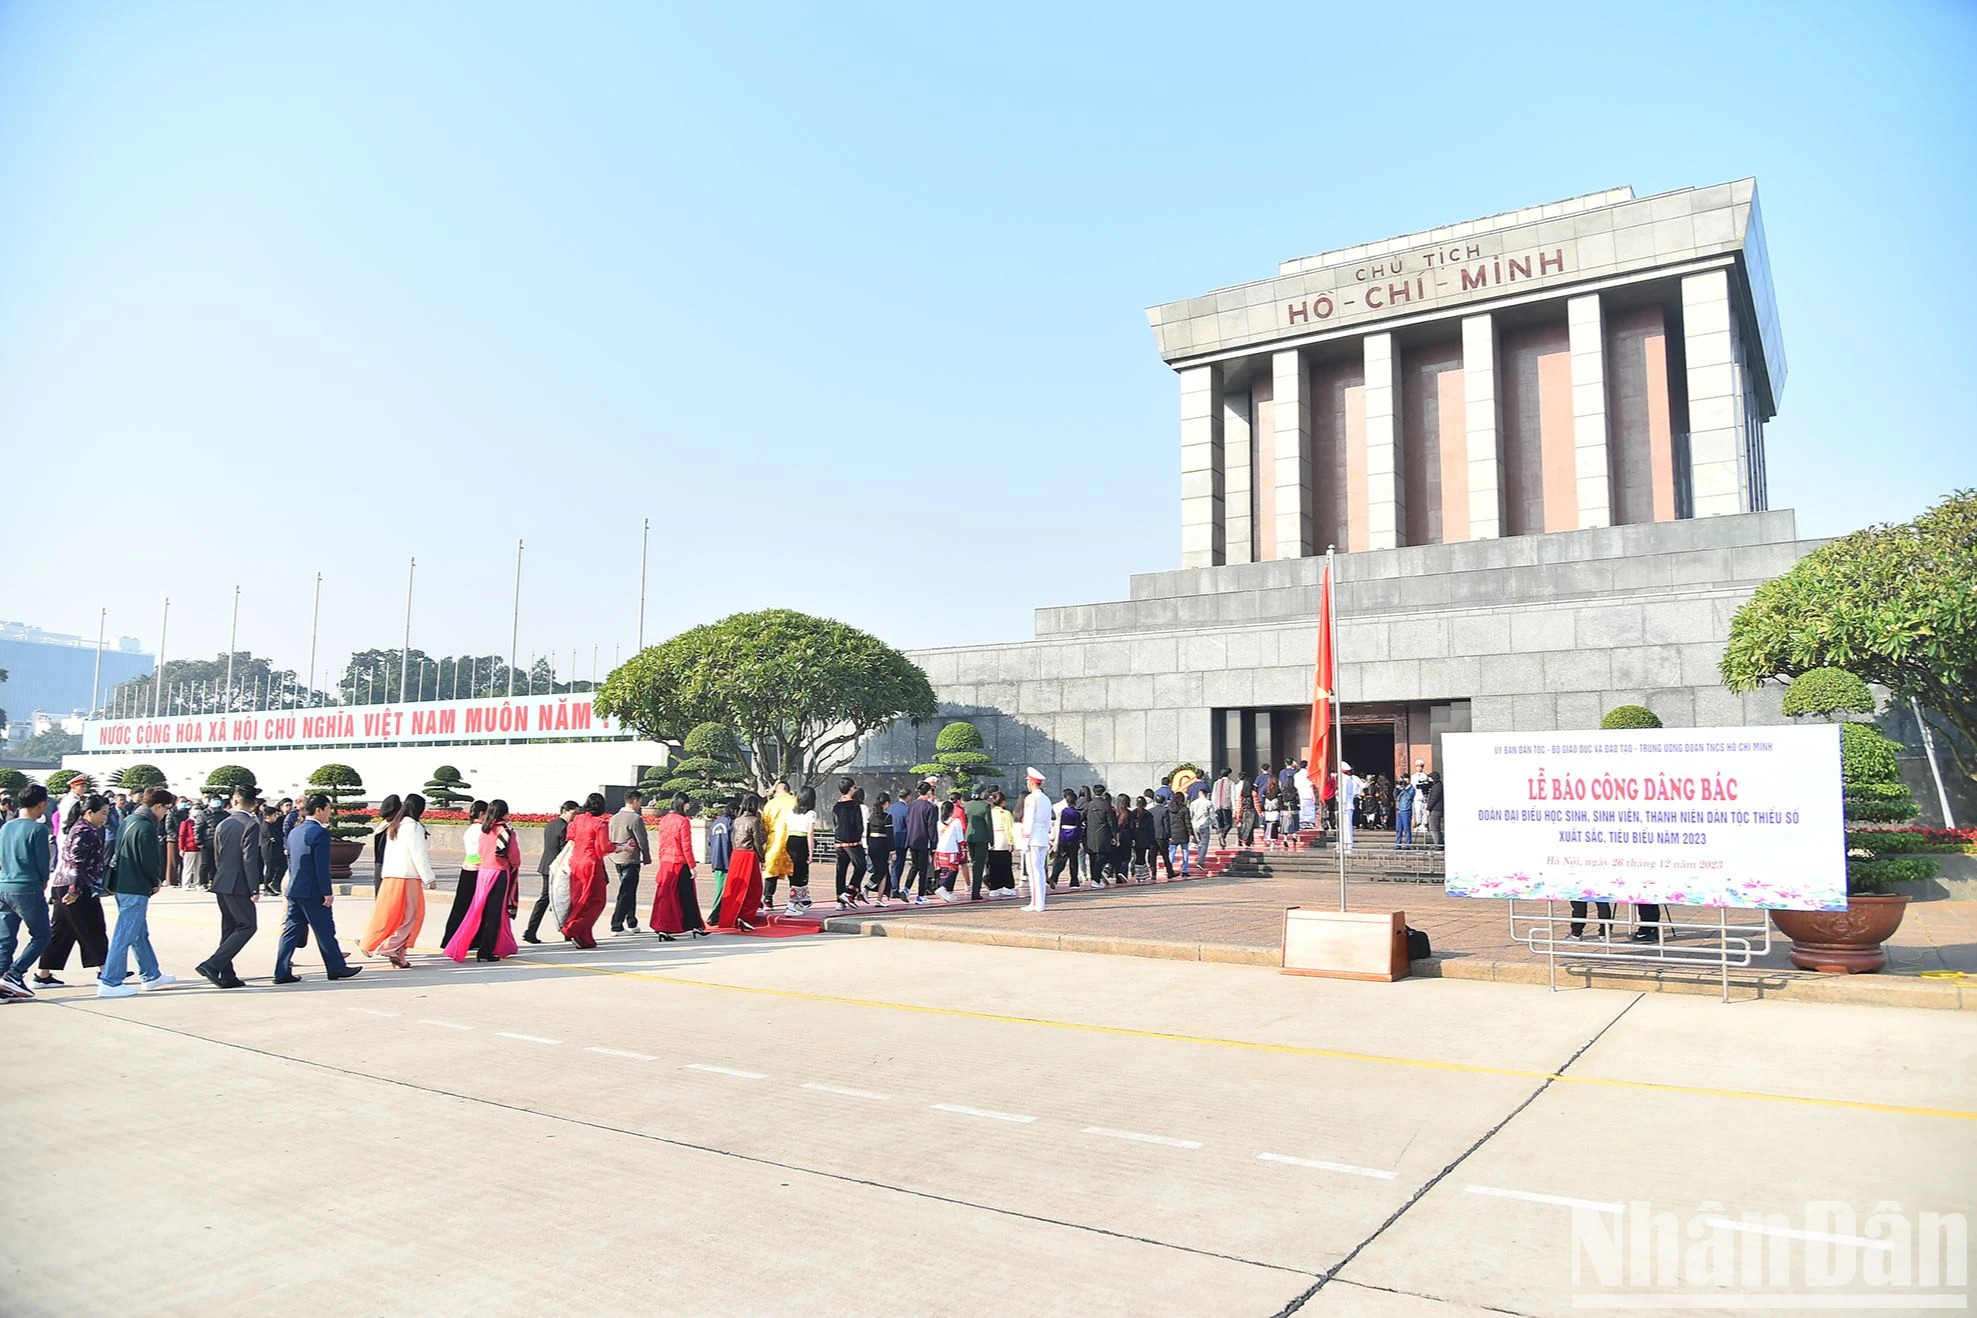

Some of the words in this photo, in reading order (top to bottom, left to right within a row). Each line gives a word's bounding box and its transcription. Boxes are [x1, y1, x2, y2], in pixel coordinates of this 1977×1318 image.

[1288, 290, 1335, 325] HỒ
[1365, 272, 1425, 309] CHÍ
[99, 722, 132, 745] NƯỚC
[136, 720, 171, 748] CỘNG
[208, 717, 227, 742] XÃ
[233, 715, 258, 745] HỘI
[264, 711, 296, 740] CHỦ
[302, 711, 355, 739] NGHĨA
[364, 708, 403, 740] VIỆT
[411, 709, 456, 735] NAM
[465, 701, 529, 734] MUÔN
[538, 697, 592, 731] NĂM
[1528, 767, 1548, 800] LỄ
[1551, 772, 1586, 800] BÁO
[1591, 772, 1639, 800] CÔNG
[1644, 771, 1695, 801] DÂNG
[1700, 771, 1738, 801] BÁC
[1478, 807, 1502, 821] ĐOÀN
[1504, 810, 1519, 824] ĐẠI
[1521, 805, 1542, 821] BIỂU
[1544, 810, 1563, 824] HỌC
[1565, 810, 1590, 823] SINH,
[1593, 810, 1615, 822] SINH
[1618, 808, 1643, 824] VIÊN,
[1645, 811, 1677, 823] THANH
[1680, 808, 1704, 823] NIÊN
[1707, 809, 1728, 824] DÂN
[1731, 809, 1750, 827] TỘC
[1753, 806, 1782, 824] THIỂU
[1785, 807, 1799, 824] SỐ
[1559, 827, 1582, 843] XUẤT
[1609, 828, 1629, 843] TIÊU
[1632, 827, 1654, 844] BIỂU
[1656, 830, 1680, 844] NĂM
[1682, 832, 1707, 845] 2023
[1611, 857, 1624, 867] 26
[1659, 859, 1671, 868] 12
[1699, 860, 1724, 869] 2023
